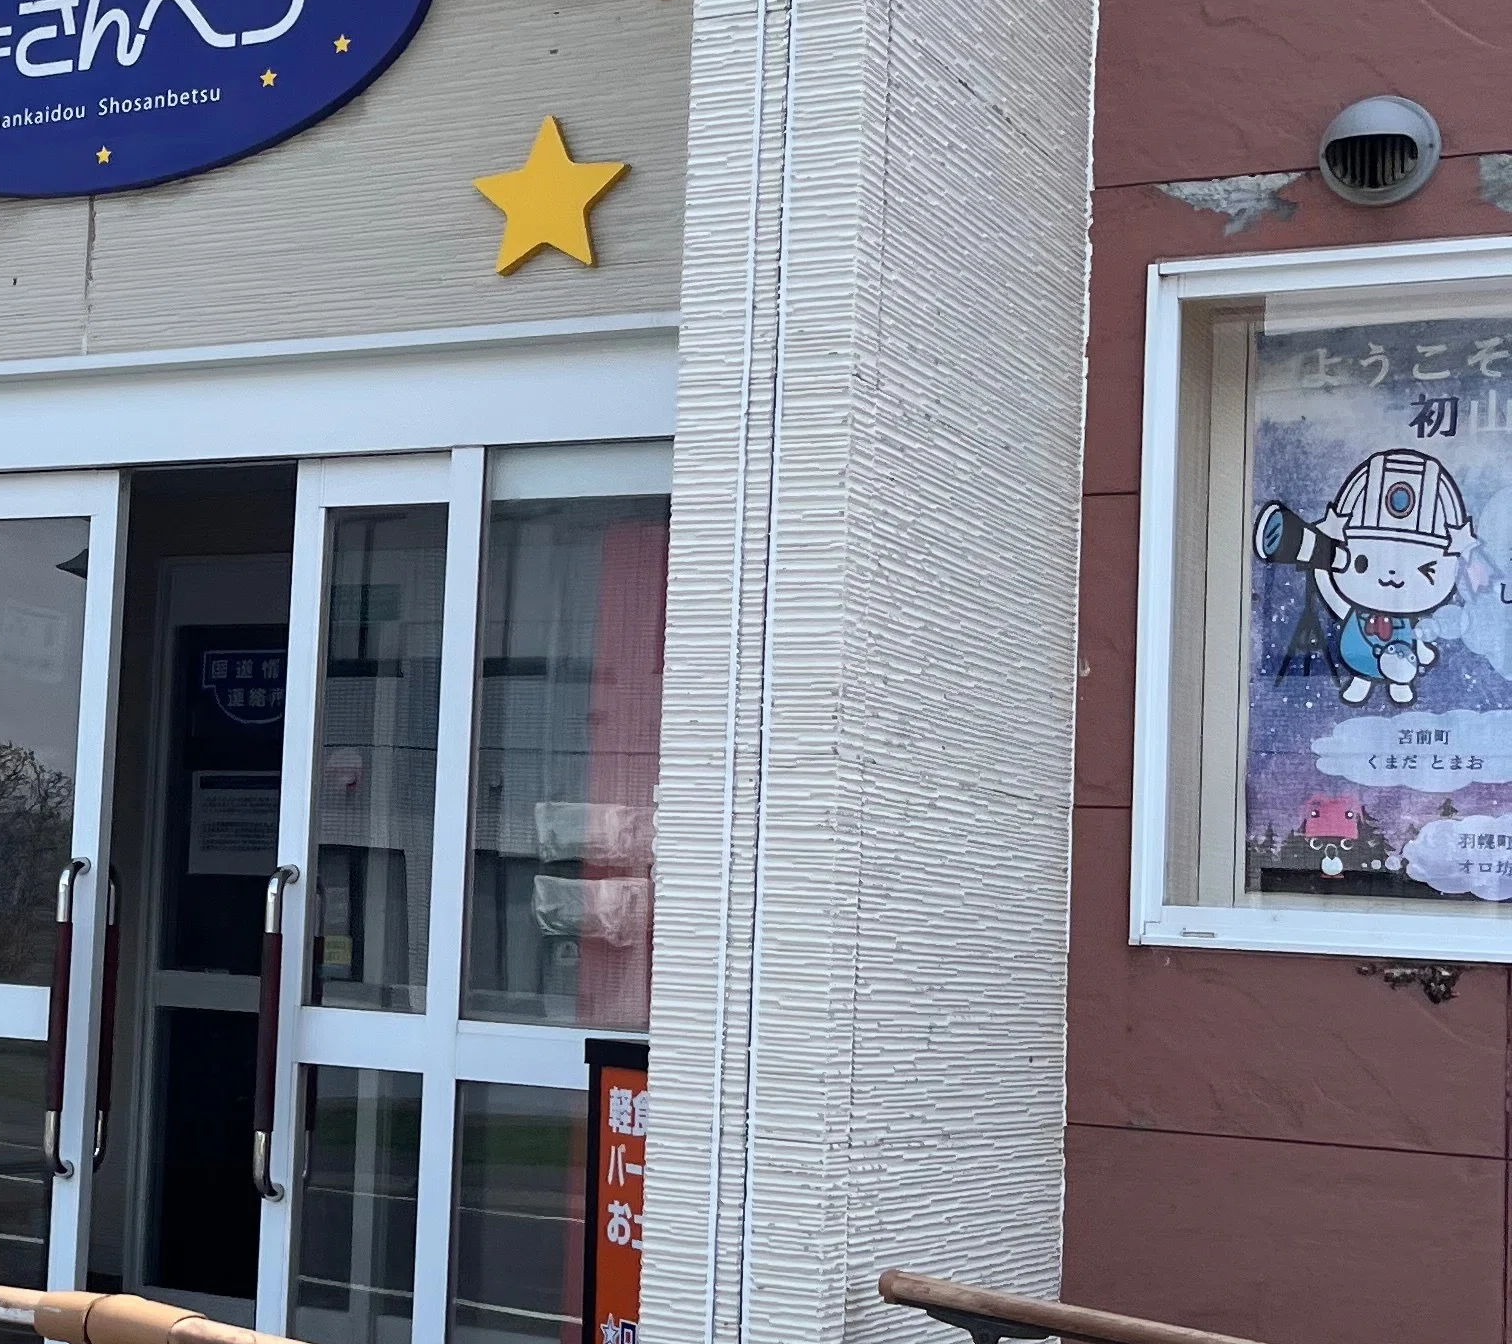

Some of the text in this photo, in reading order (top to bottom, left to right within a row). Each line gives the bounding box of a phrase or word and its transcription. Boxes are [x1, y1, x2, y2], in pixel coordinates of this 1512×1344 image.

[98, 86, 221, 116] Shosanbetsu
[1368, 753, 1485, 771] くまだ とまお
